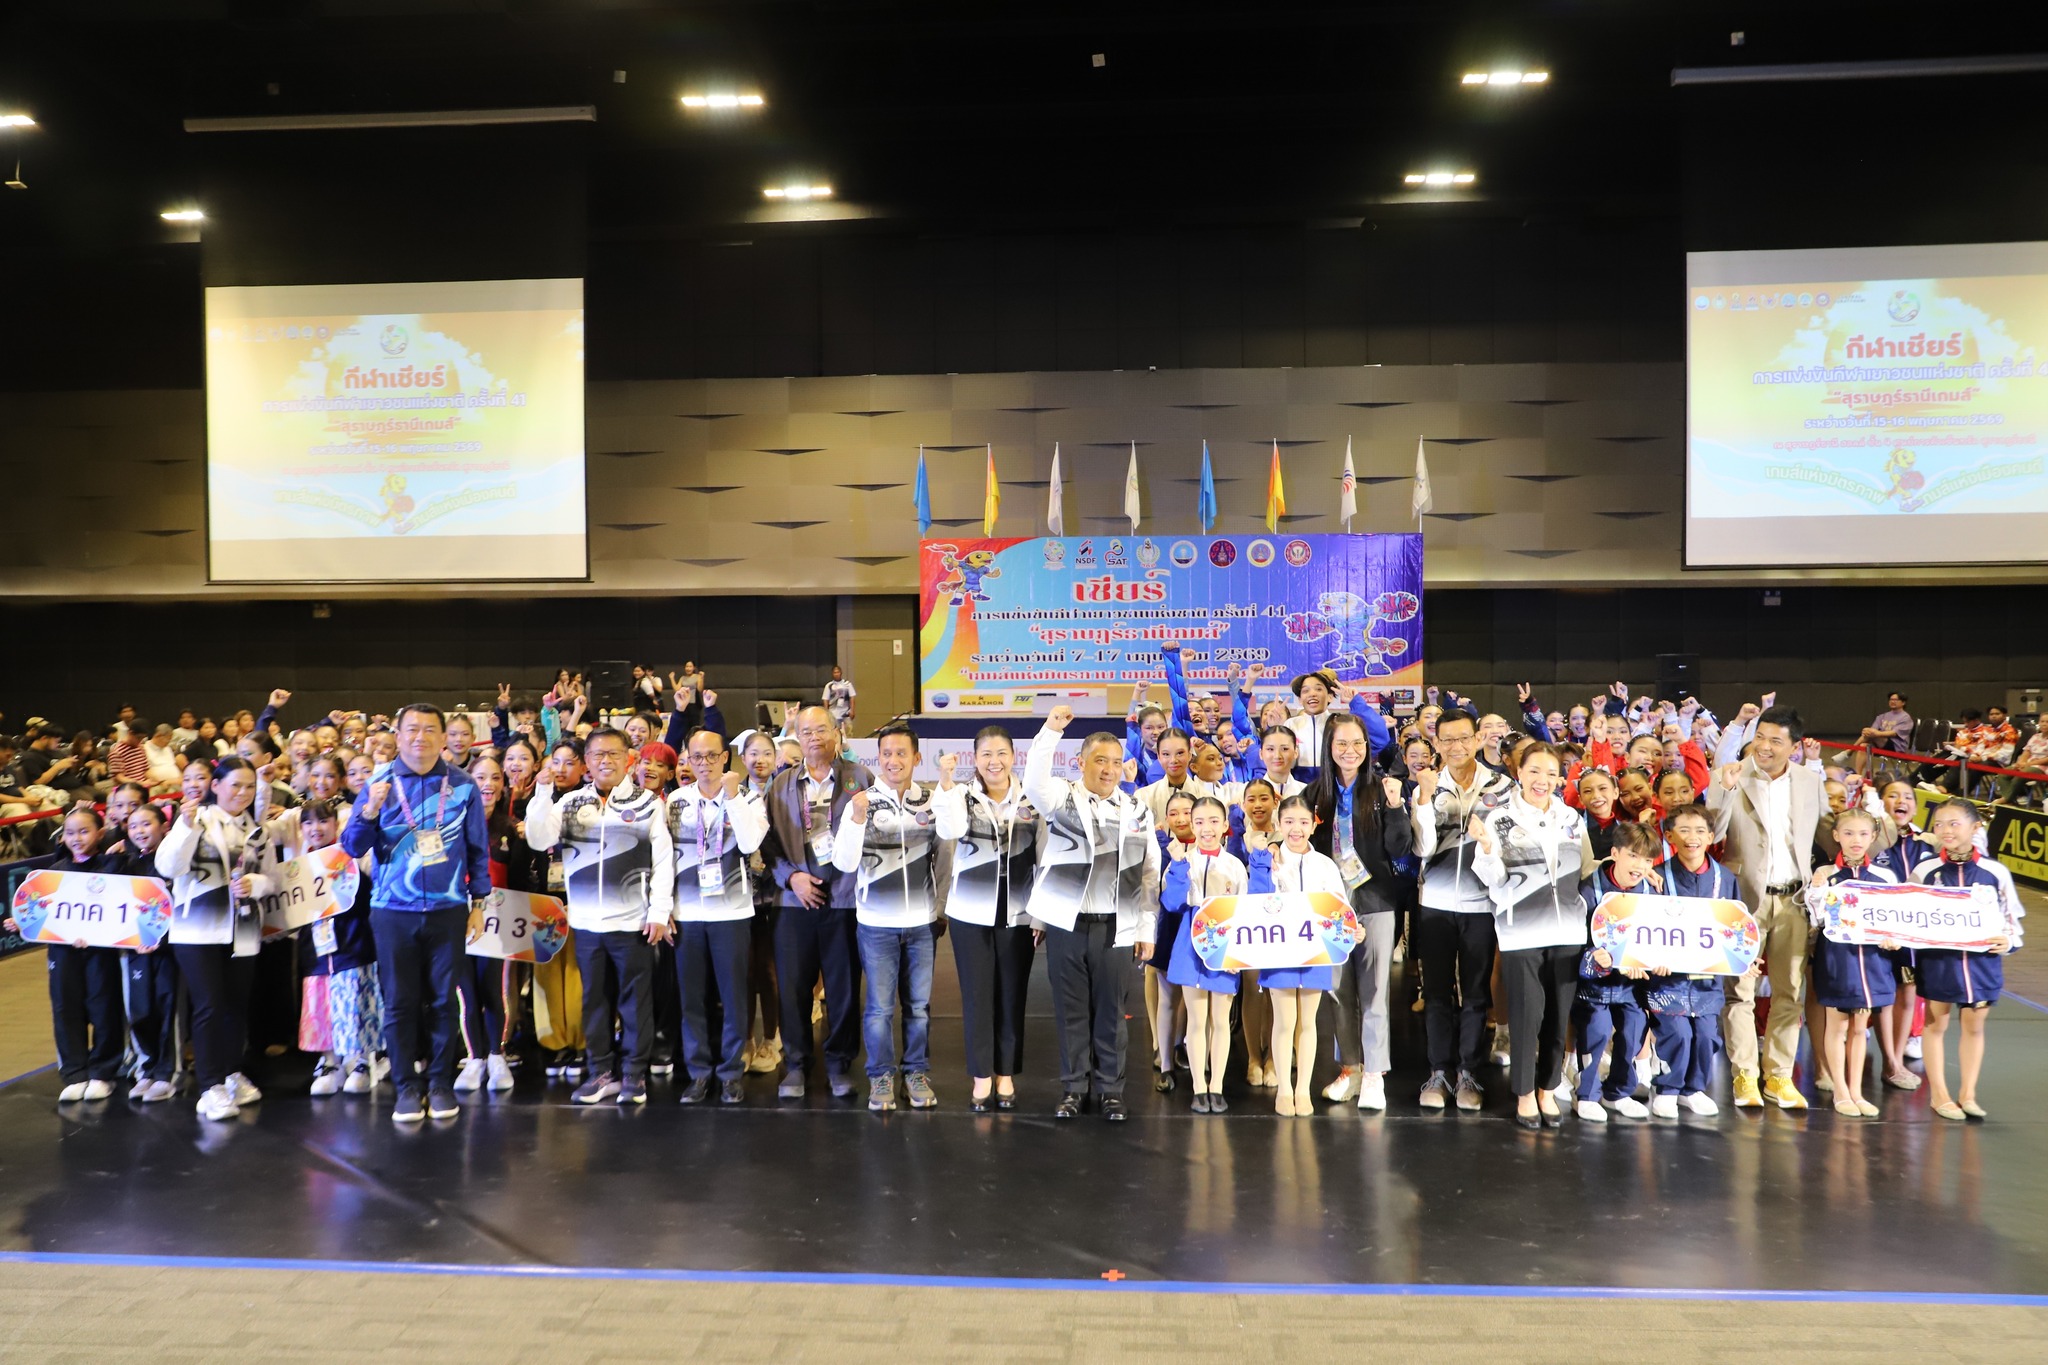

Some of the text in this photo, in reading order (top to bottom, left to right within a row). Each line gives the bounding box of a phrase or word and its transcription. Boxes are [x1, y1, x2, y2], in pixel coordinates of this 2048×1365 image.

[1846, 332, 1963, 359] กีฬาเชียร์
[344, 364, 445, 389] กีฬาเชียร์
[1753, 361, 1986, 384] การแข่งขันกีฬาเยาวชนแห่งชาติ
[510, 393, 527, 406] 41
[1970, 413, 2004, 426] 2569
[453, 441, 482, 453] 2569
[1919, 456, 2044, 507] กมส์แห่งเมืองคนดี
[1075, 557, 1097, 565] NSDF
[1107, 558, 1128, 566] SAT
[1072, 569, 1171, 603] เชียร์
[1261, 604, 1287, 618] 41
[1214, 648, 1271, 661] 2569
[1999, 819, 2048, 863] ALG
[313, 876, 326, 897] 2
[55, 901, 127, 924] ภาค 1
[1862, 906, 1982, 929] สุราษฎร์ธานี
[511, 918, 528, 938] 3
[1236, 920, 1314, 945] ภาค 4
[1635, 926, 1714, 949] ภาค 5
